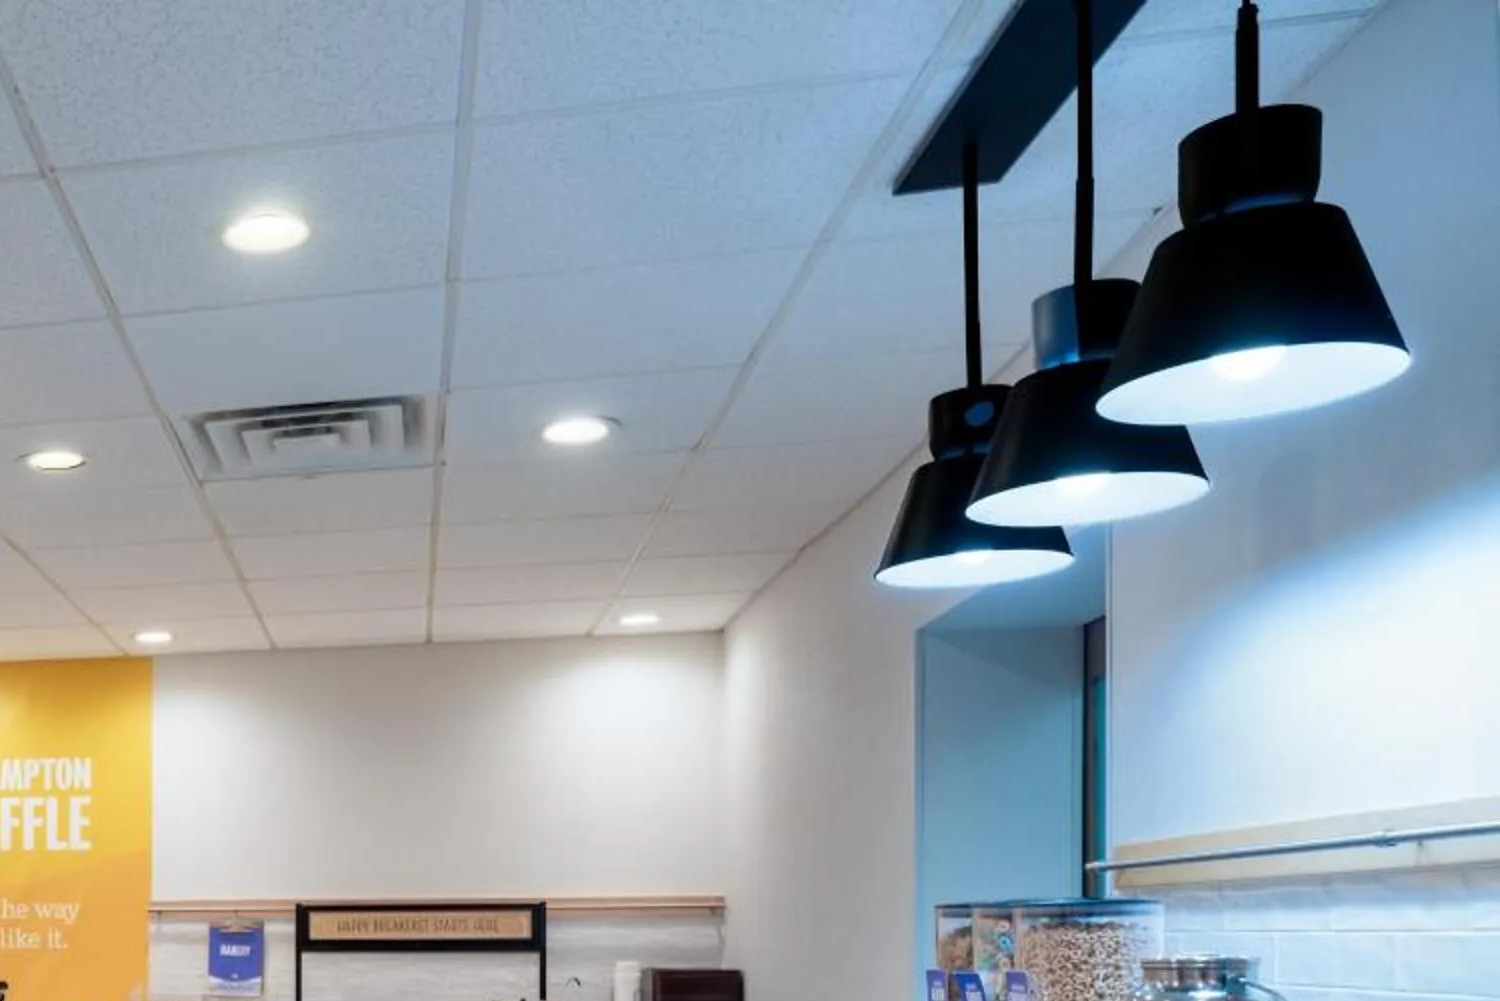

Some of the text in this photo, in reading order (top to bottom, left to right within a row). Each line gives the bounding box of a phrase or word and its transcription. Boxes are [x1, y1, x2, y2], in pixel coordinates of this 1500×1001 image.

[35, 901, 80, 924] way
[0, 927, 41, 949] like
[47, 928, 68, 949] it.
